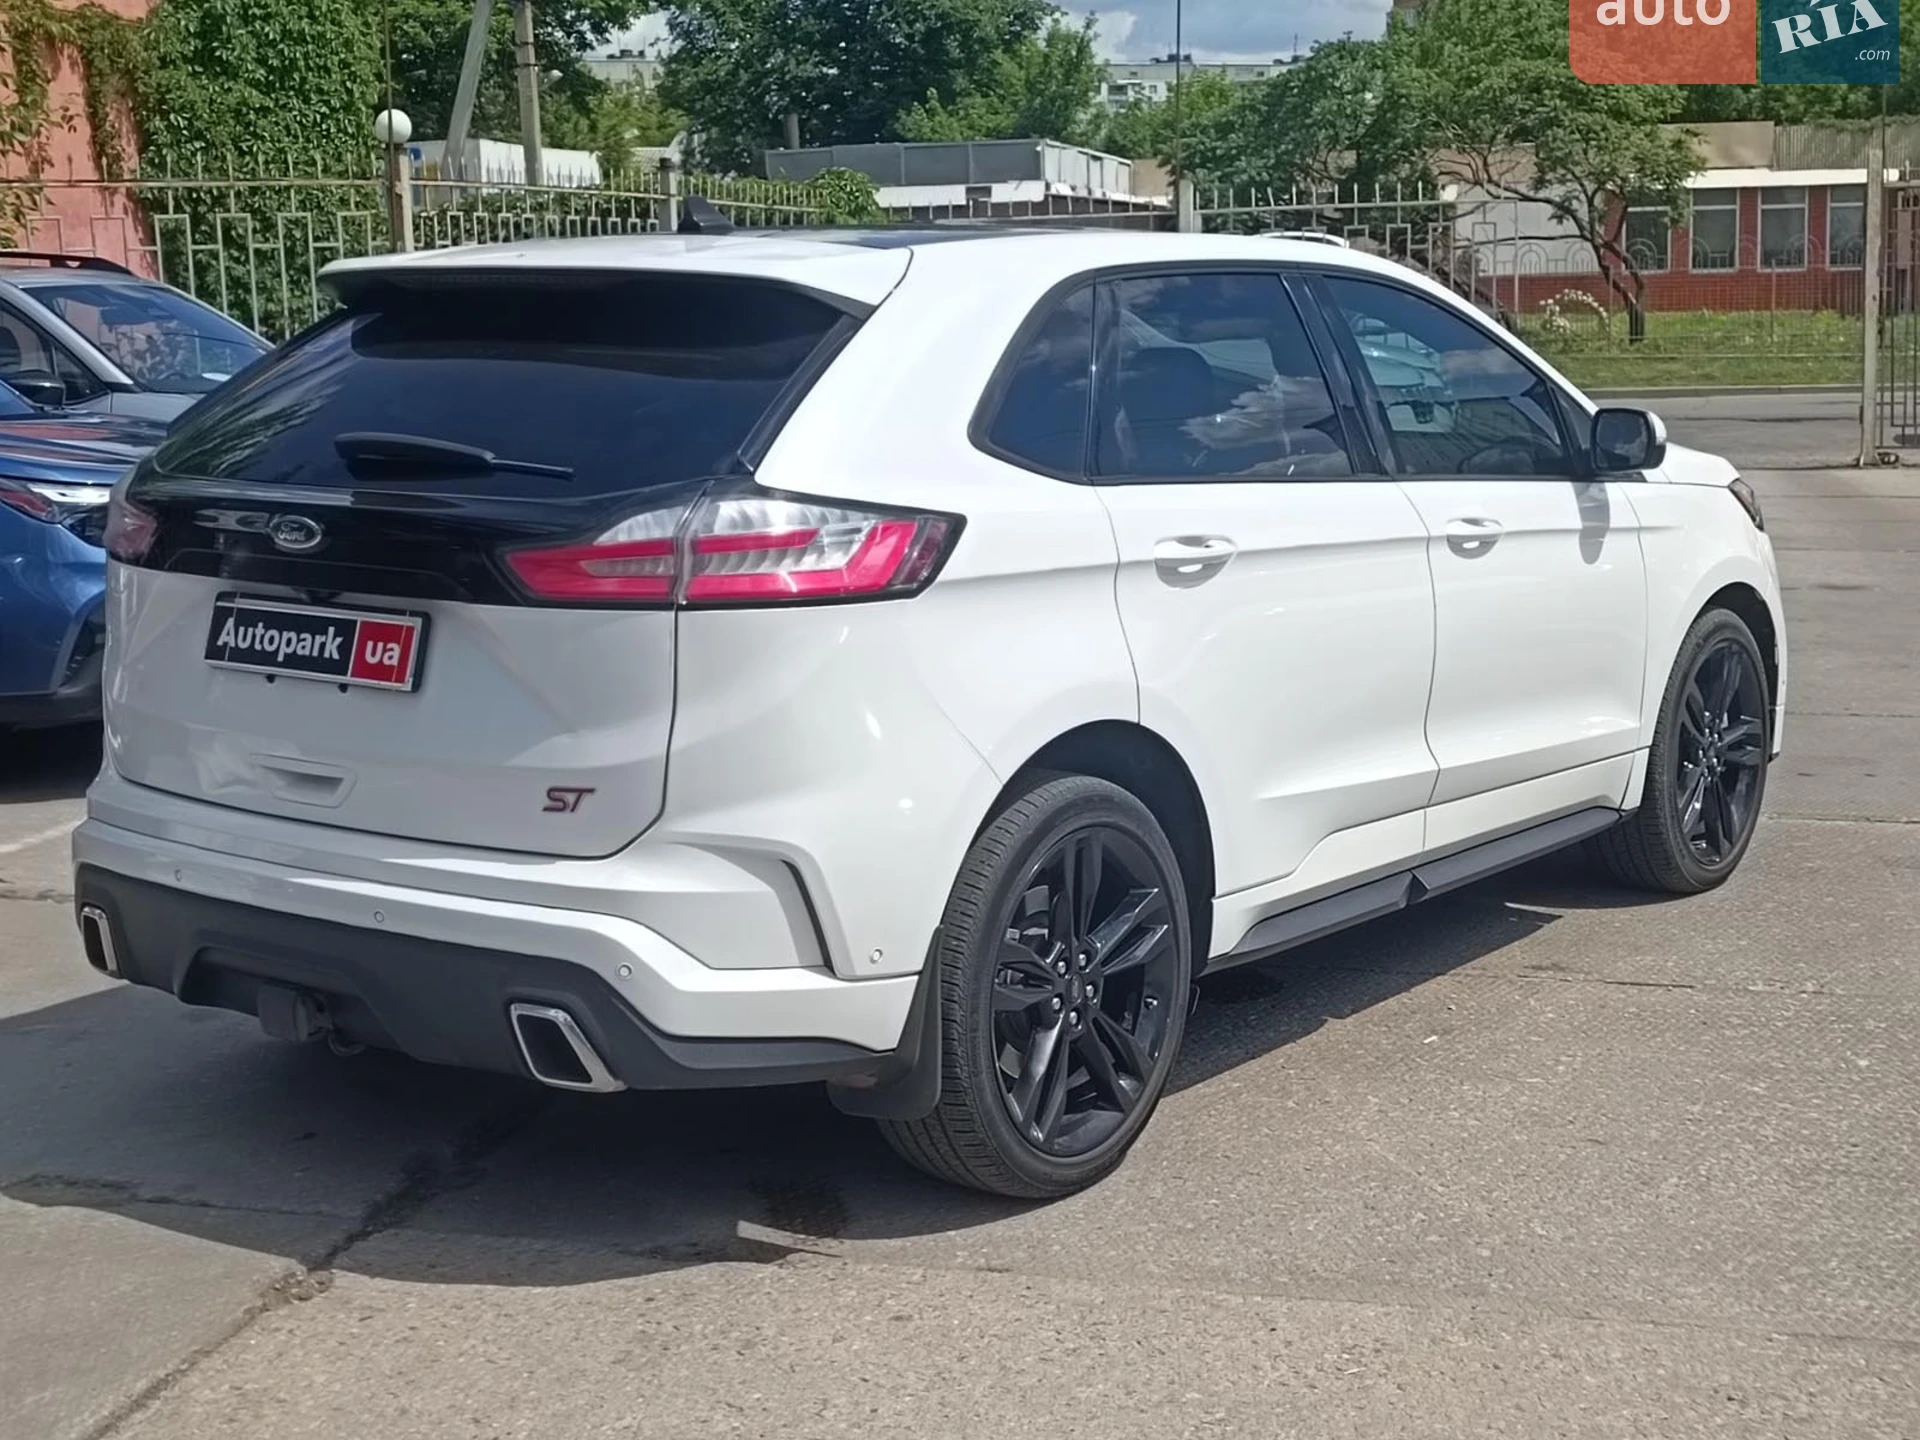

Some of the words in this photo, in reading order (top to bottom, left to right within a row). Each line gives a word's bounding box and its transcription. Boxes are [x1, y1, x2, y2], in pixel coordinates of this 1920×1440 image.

[216, 617, 344, 662] Autopark
[364, 640, 401, 666] ua
[541, 785, 596, 813] ST
